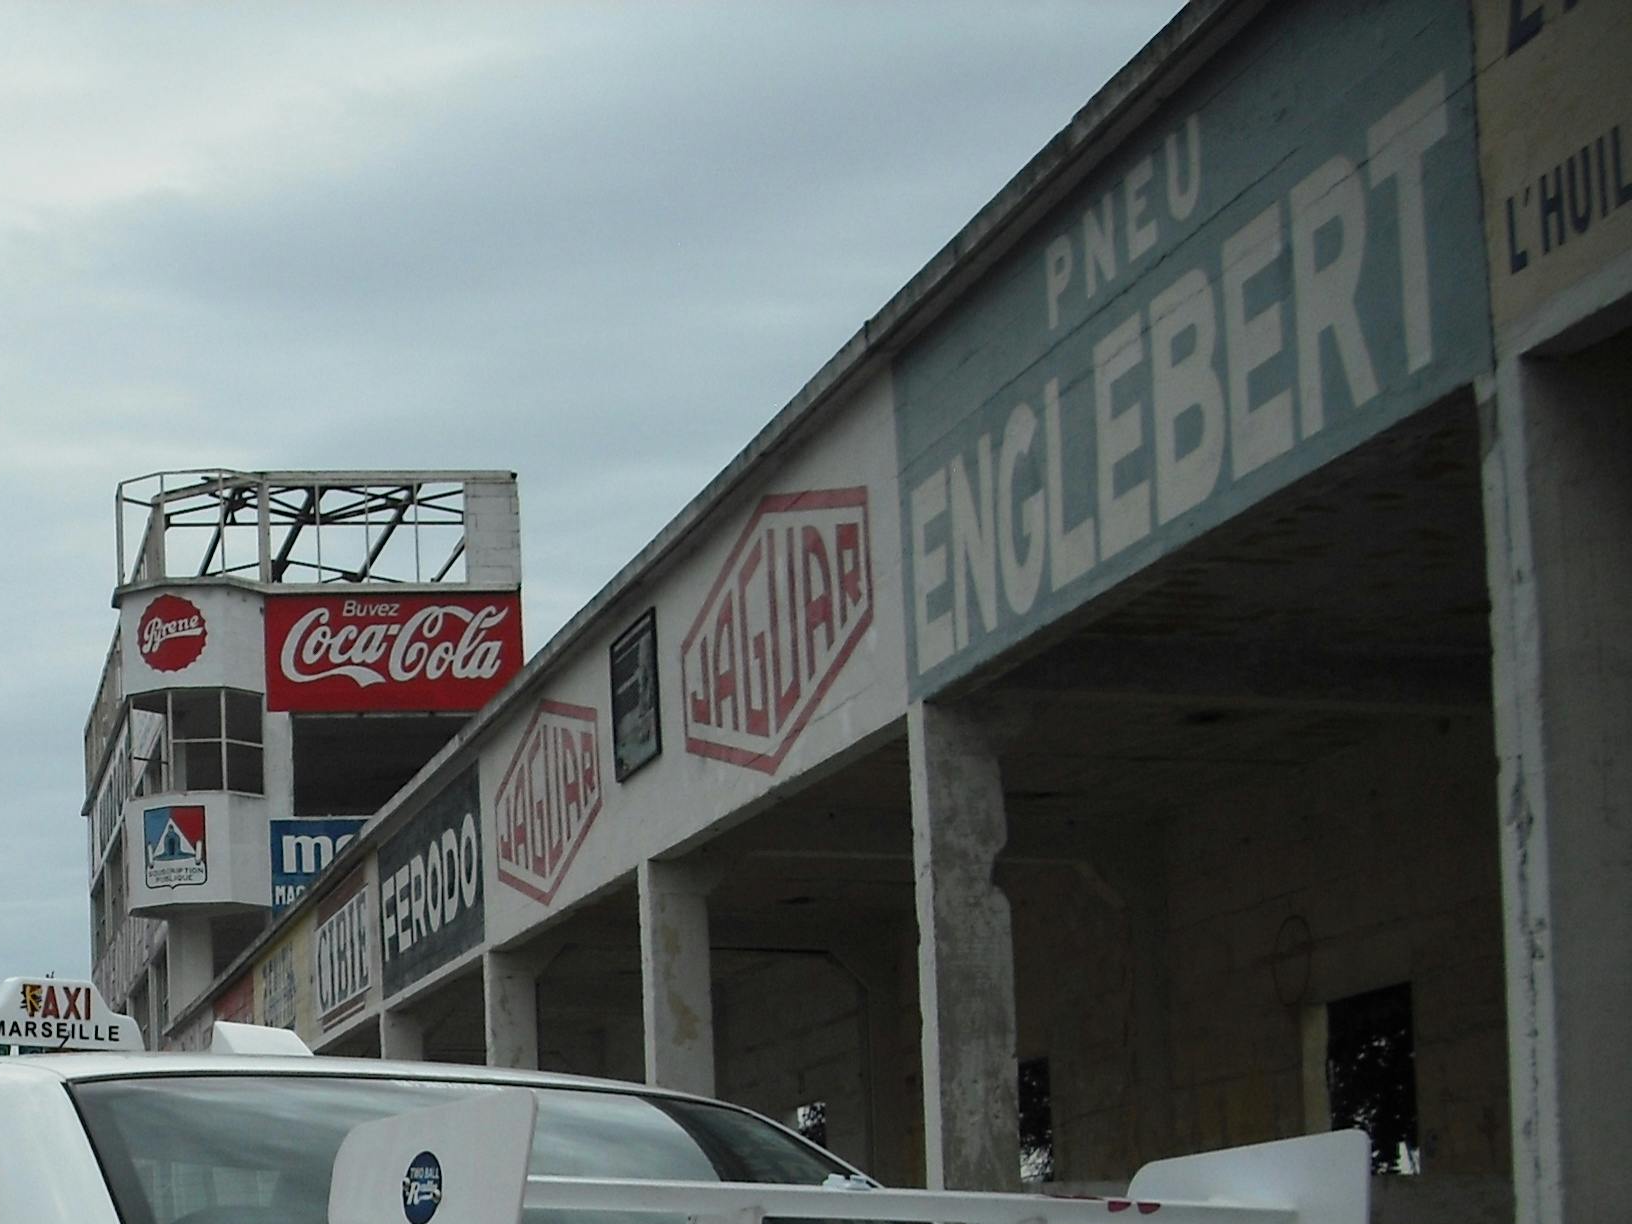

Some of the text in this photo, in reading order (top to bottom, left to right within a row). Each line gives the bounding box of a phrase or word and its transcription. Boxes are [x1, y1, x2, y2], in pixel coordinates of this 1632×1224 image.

[1045, 113, 1199, 330] PNEU
[911, 70, 1449, 677] ENGLEBERT
[141, 615, 203, 653] Pyrene
[280, 605, 509, 688] Coca-Cola
[342, 600, 401, 618] Buvez
[689, 522, 864, 739] JAGUAR
[499, 724, 596, 879] JAGUAR
[381, 813, 478, 962] FERODO
[21, 983, 91, 1021] TAXI
